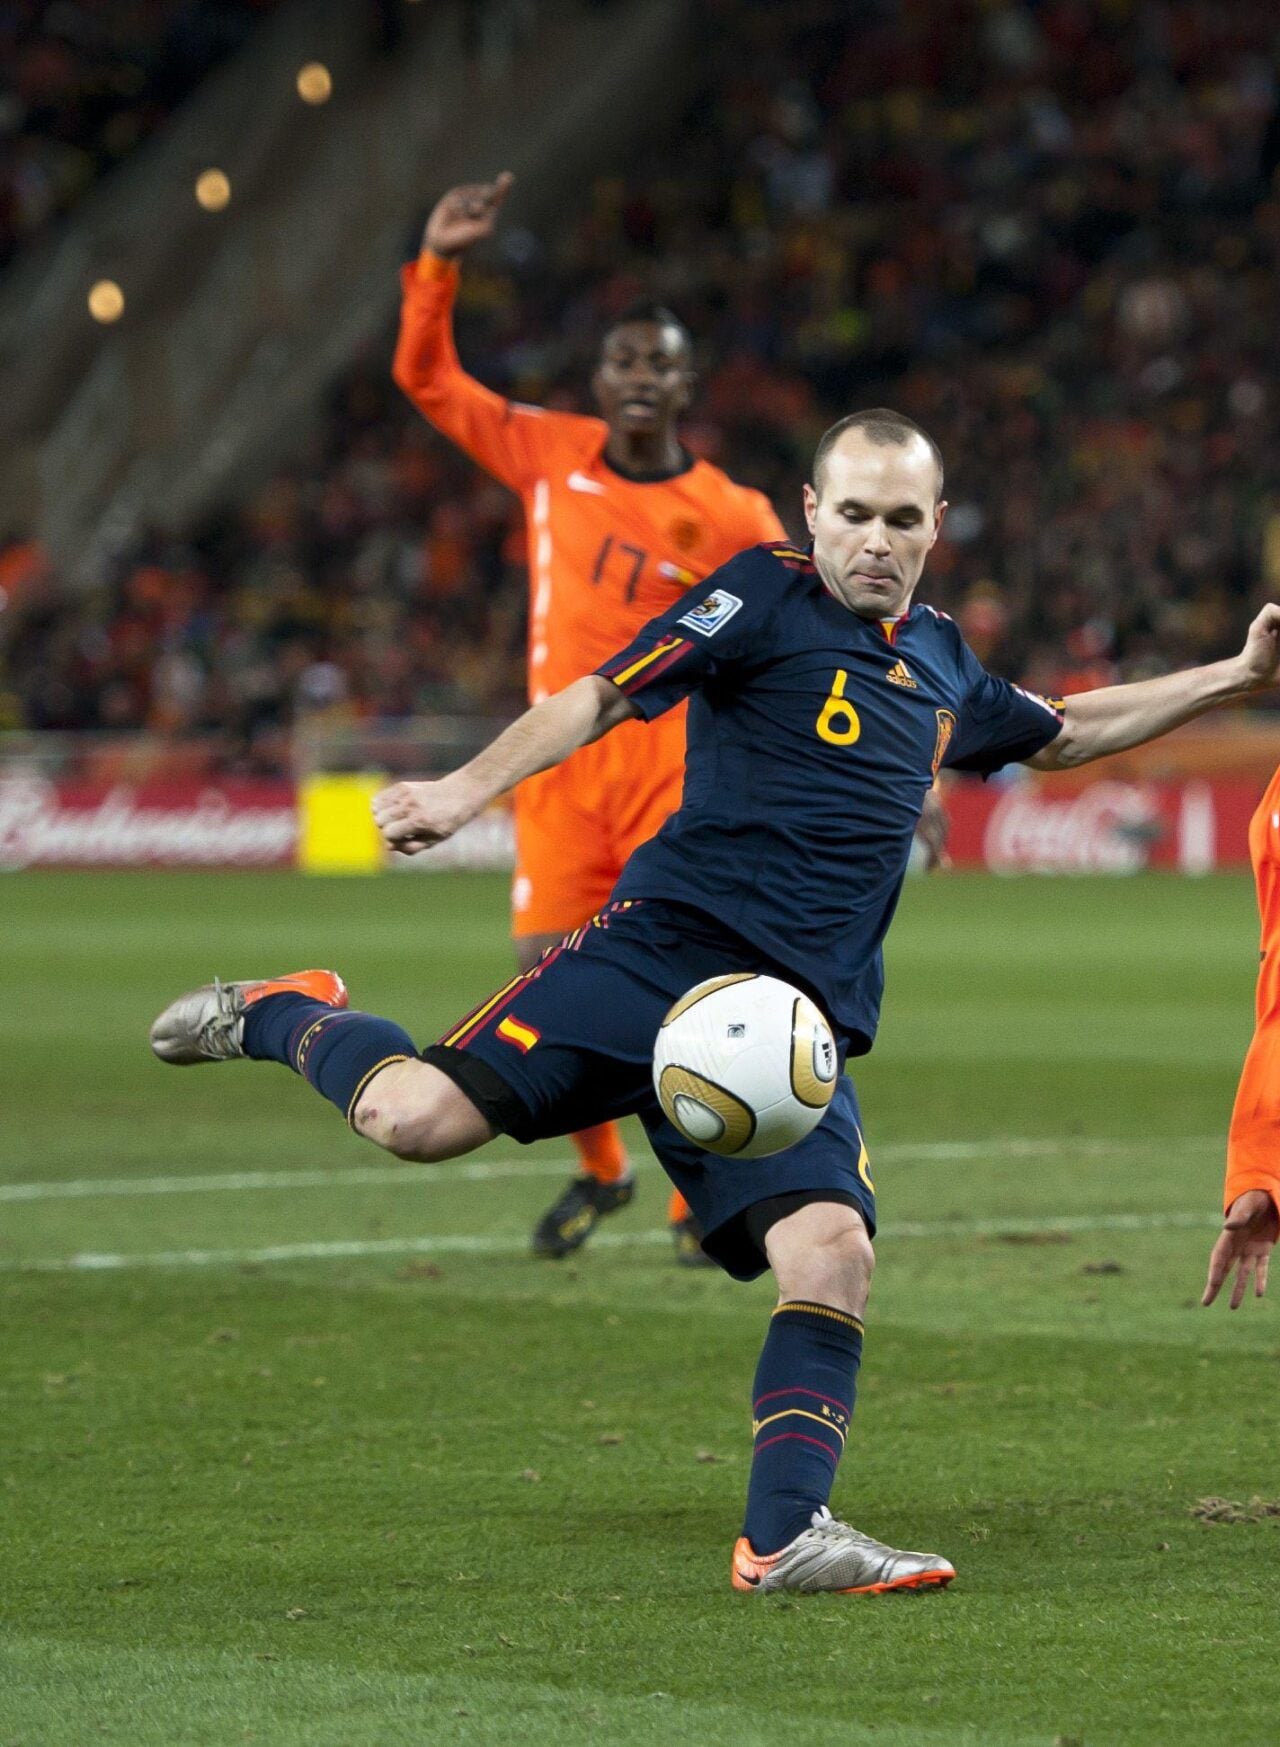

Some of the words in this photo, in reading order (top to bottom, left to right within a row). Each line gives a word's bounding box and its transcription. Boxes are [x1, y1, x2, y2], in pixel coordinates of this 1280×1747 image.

[591, 534, 649, 603] 17
[816, 669, 861, 746] 6
[886, 674, 917, 689] adidas
